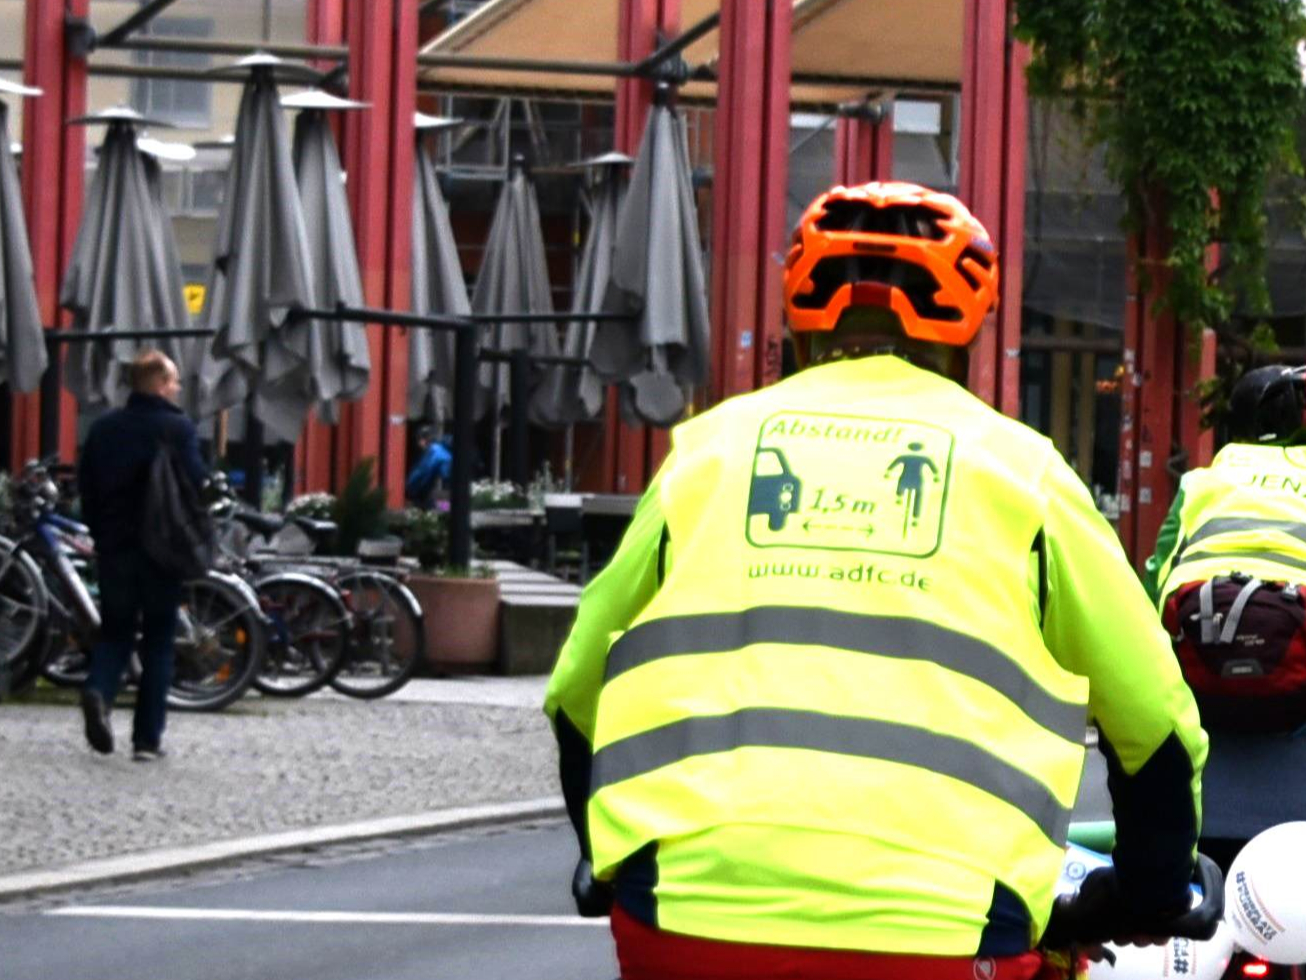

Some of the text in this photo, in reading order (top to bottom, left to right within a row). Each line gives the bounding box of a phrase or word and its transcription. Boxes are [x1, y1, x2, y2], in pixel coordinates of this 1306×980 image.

[768, 420, 902, 442] Abstand!
[810, 488, 876, 514] 1,5 m
[748, 563, 933, 592] www.adfc.de
